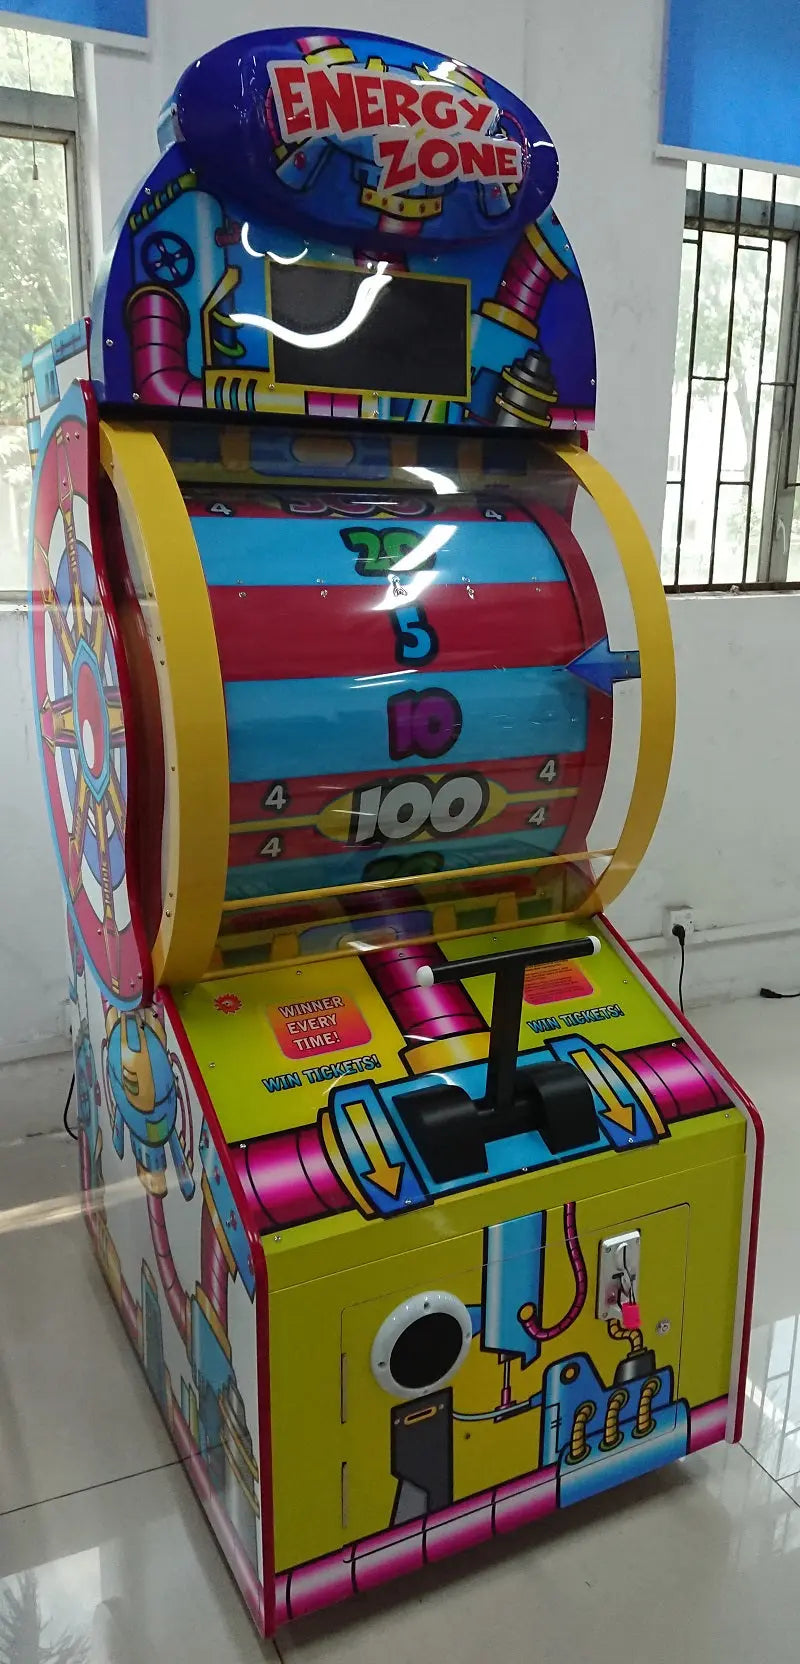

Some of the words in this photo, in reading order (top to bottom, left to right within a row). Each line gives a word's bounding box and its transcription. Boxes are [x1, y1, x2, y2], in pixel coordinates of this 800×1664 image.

[271, 64, 497, 137] ENERGY
[377, 137, 519, 191] ZONE
[343, 528, 436, 576] 20
[391, 605, 435, 663] 5
[389, 689, 460, 758] 10
[538, 758, 558, 783] 4
[264, 783, 288, 811] 4
[353, 774, 486, 844] 100
[527, 806, 547, 827] 4
[259, 836, 283, 859] 4
[279, 996, 344, 1018] WINNER
[527, 1017, 561, 1033] WIN
[558, 1004, 624, 1027] TICKETS!
[286, 1014, 337, 1034] EVERY
[292, 1031, 341, 1051] TIME!
[262, 1072, 302, 1093] WIN
[303, 1054, 381, 1084] TICKETS!
